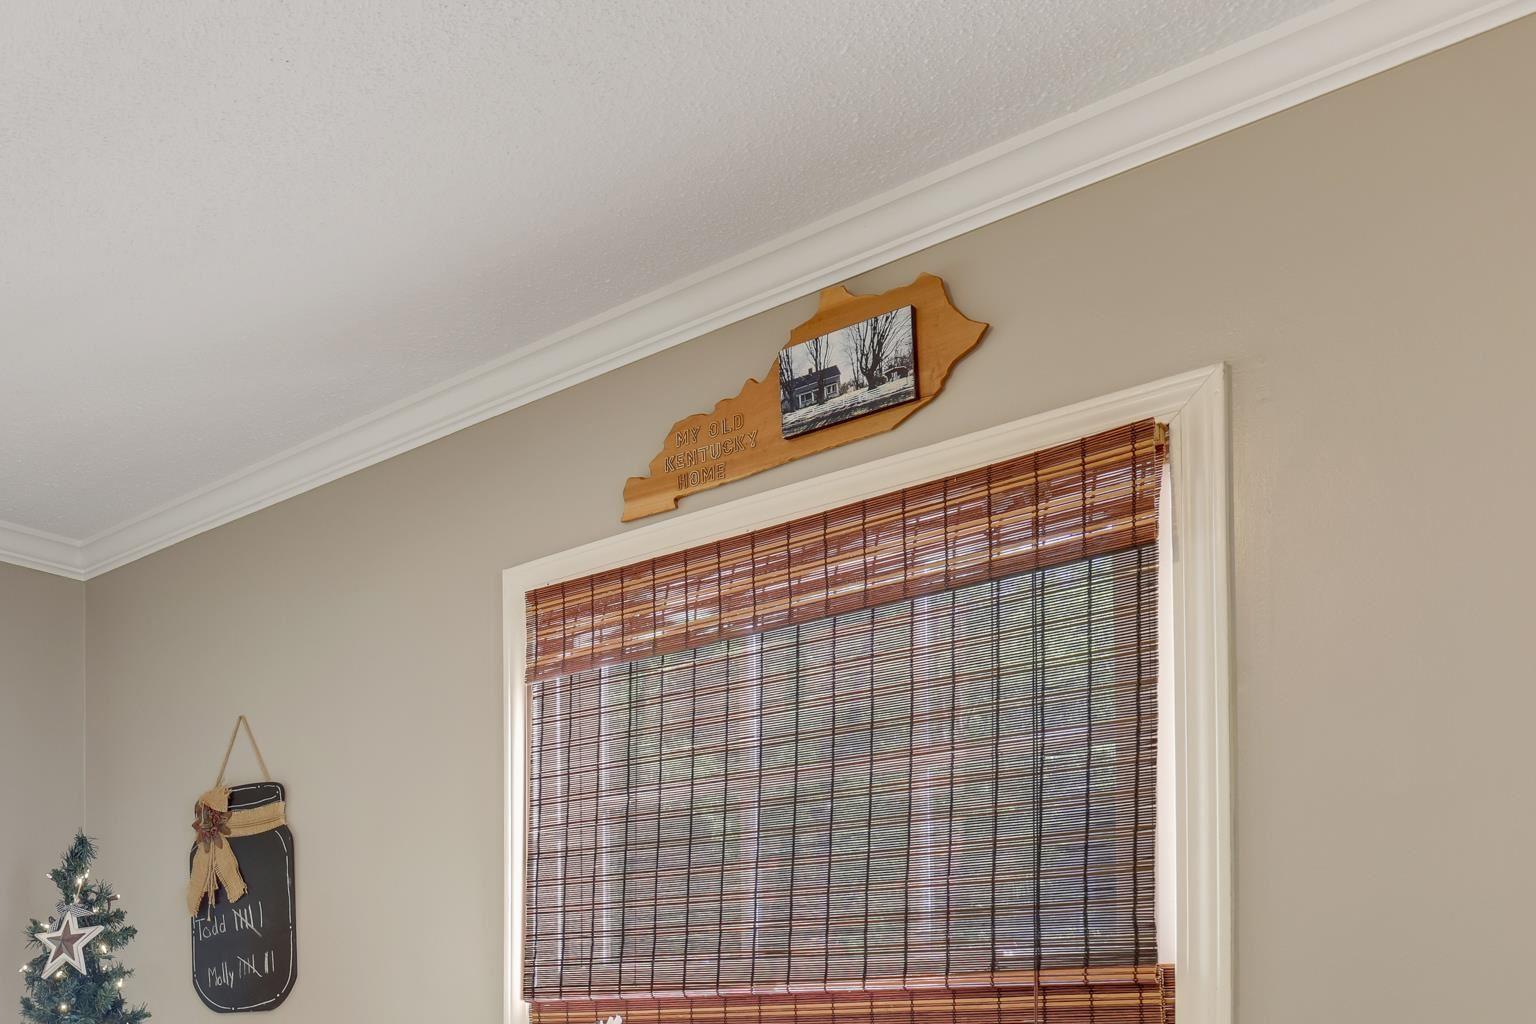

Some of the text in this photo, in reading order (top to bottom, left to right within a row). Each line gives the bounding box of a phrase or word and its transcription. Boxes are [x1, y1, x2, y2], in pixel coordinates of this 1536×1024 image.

[675, 412, 744, 449] MY OLD
[664, 429, 759, 473] KENTUCKY
[676, 463, 726, 490] HOME
[194, 914, 227, 941] Todd
[207, 961, 235, 989] Molly
